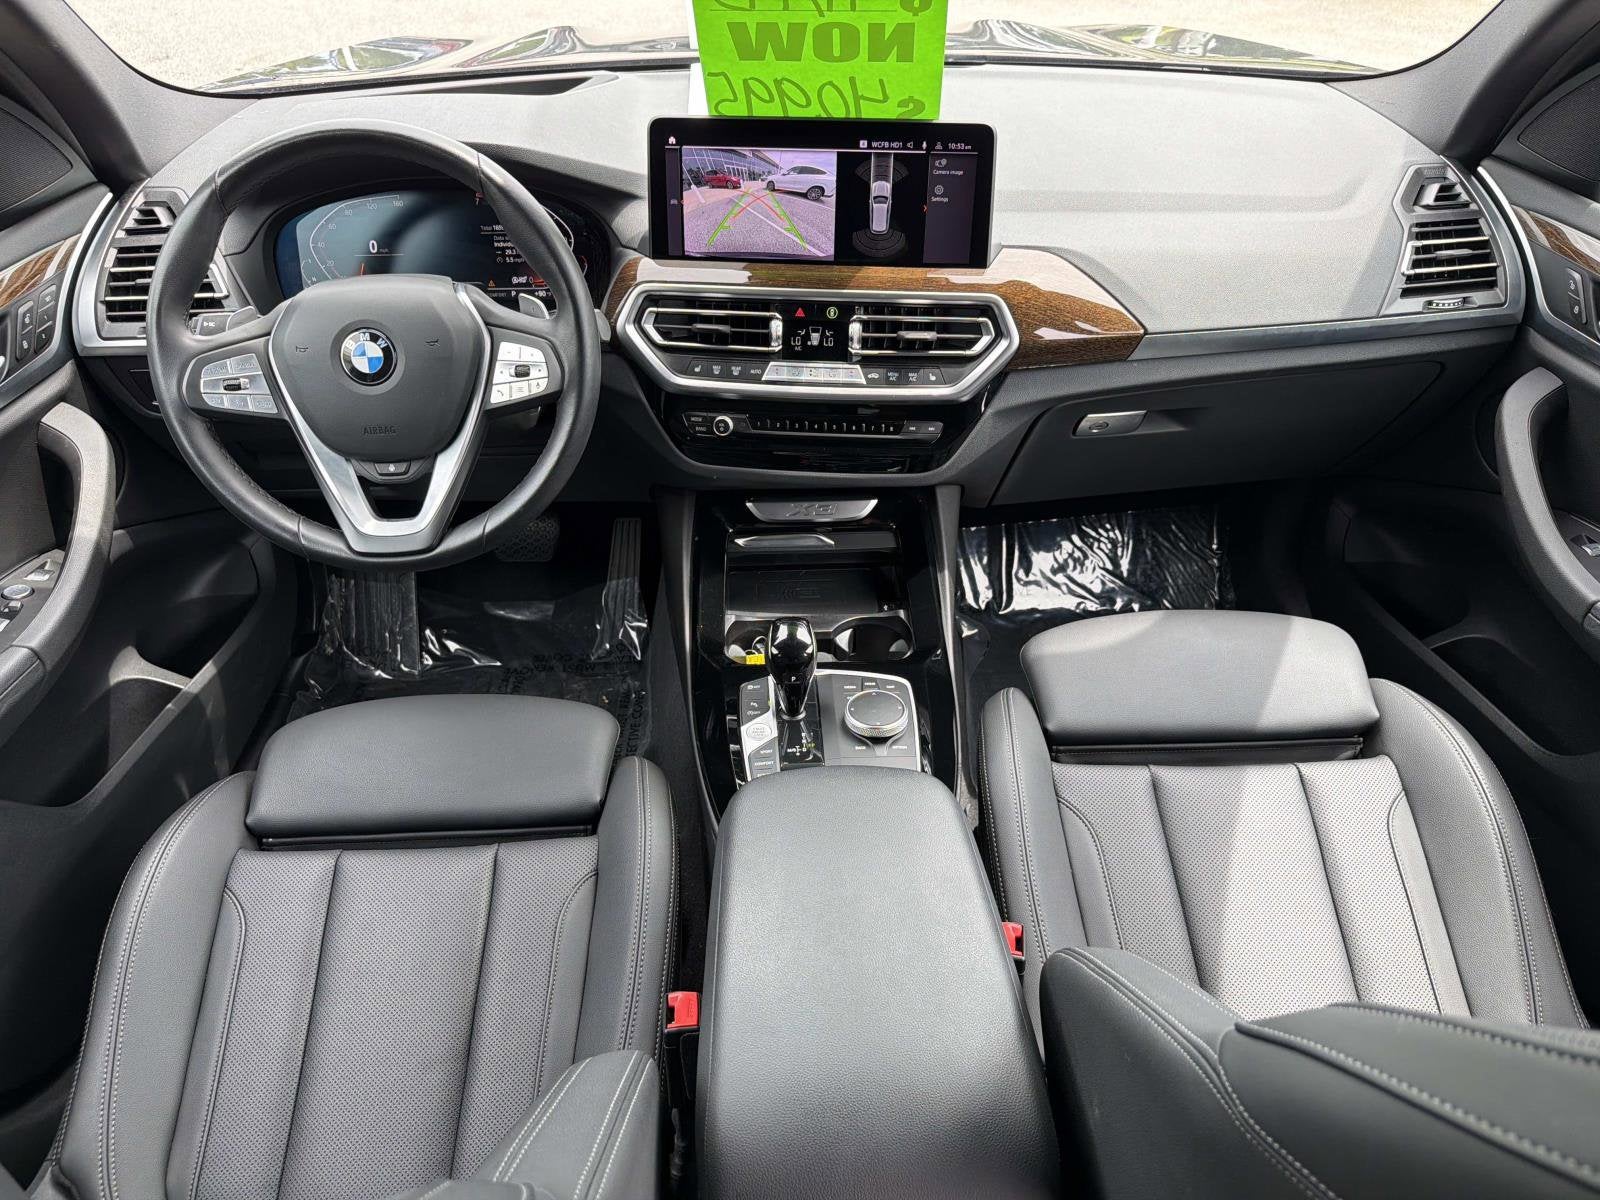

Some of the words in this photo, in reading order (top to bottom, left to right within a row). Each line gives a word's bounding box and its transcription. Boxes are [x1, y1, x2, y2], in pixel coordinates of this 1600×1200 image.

[369, 240, 377, 253] 0
[346, 332, 388, 349] BMW
[364, 426, 396, 434] AIRBAG
